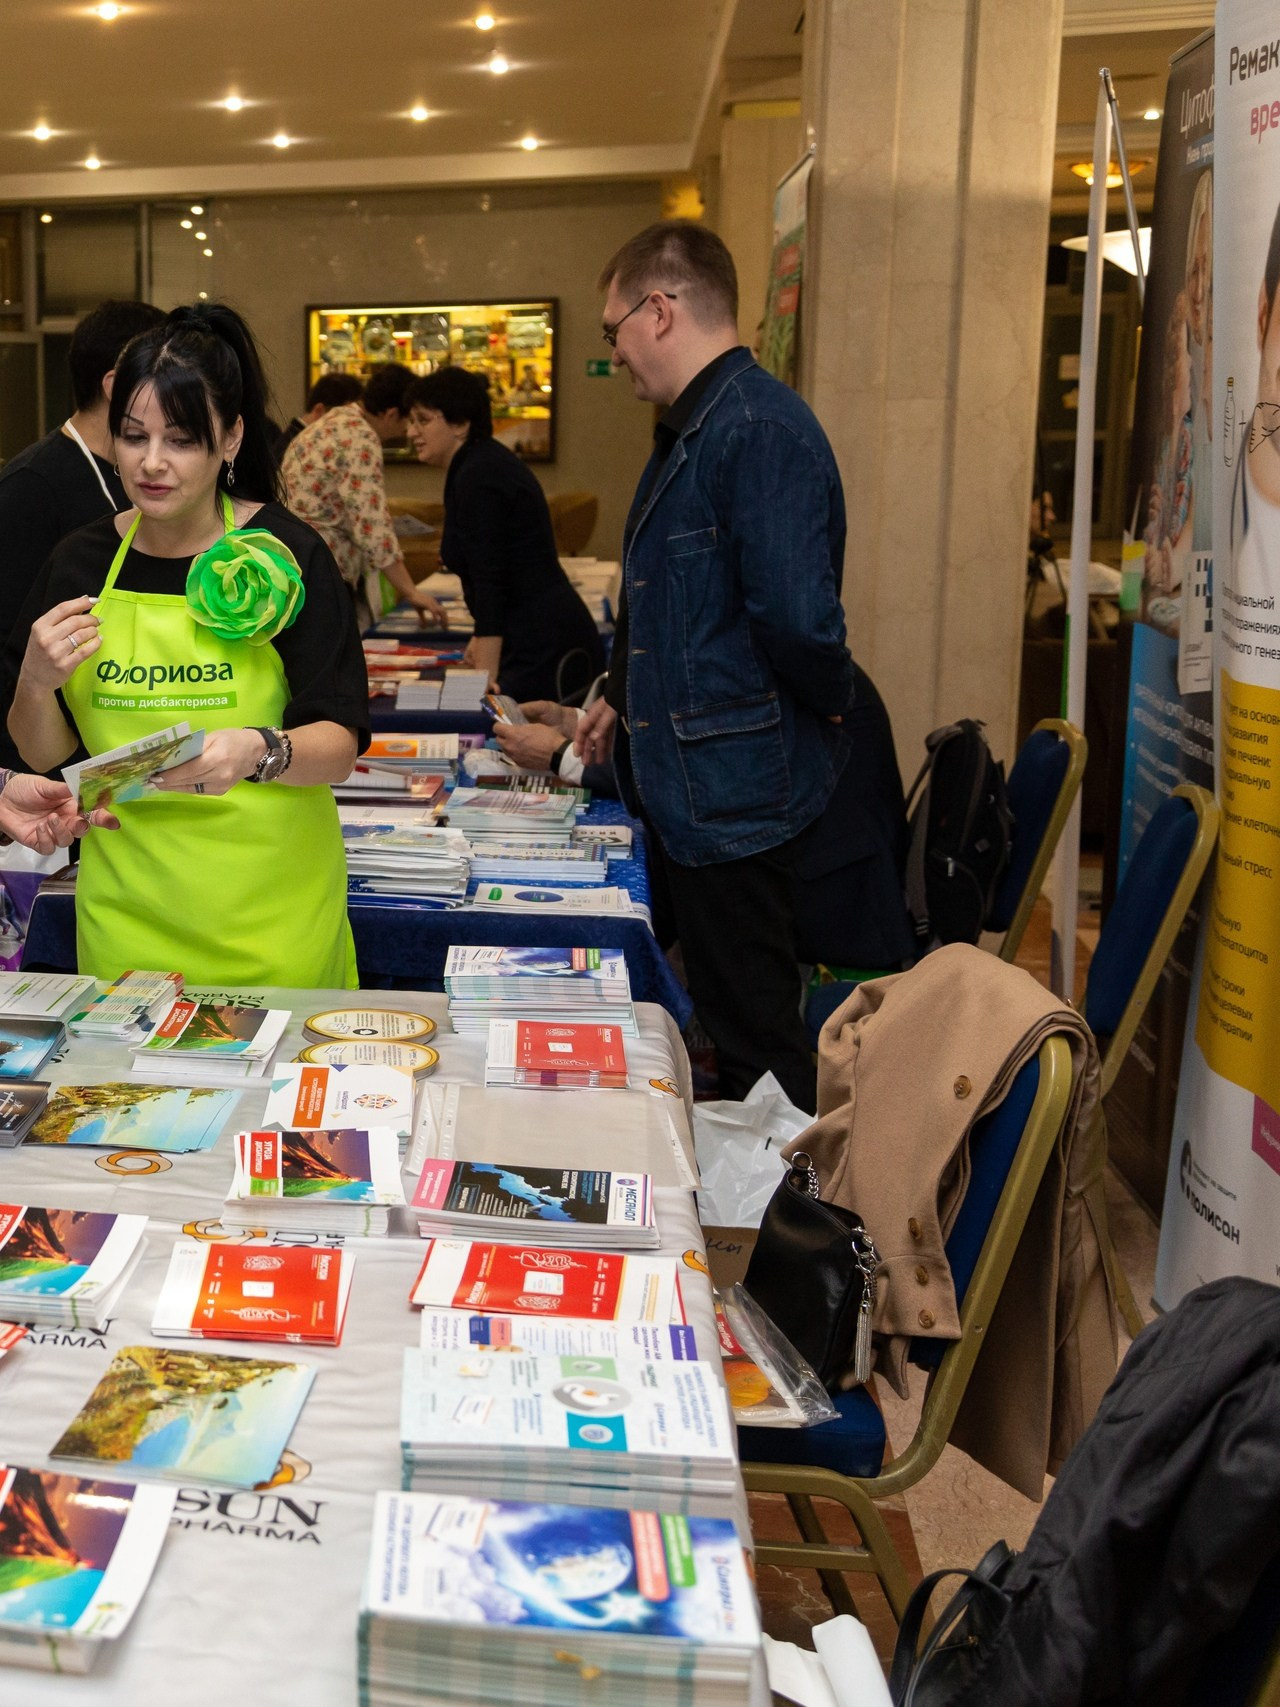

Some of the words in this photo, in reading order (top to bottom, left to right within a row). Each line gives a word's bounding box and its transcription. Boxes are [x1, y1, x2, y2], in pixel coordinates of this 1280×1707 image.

[96, 659, 234, 690] Флориоза
[98, 694, 136, 709] против
[138, 694, 229, 708] дисбактериоза
[23, 1334, 107, 1350] ARMA
[172, 1488, 329, 1527] SUN
